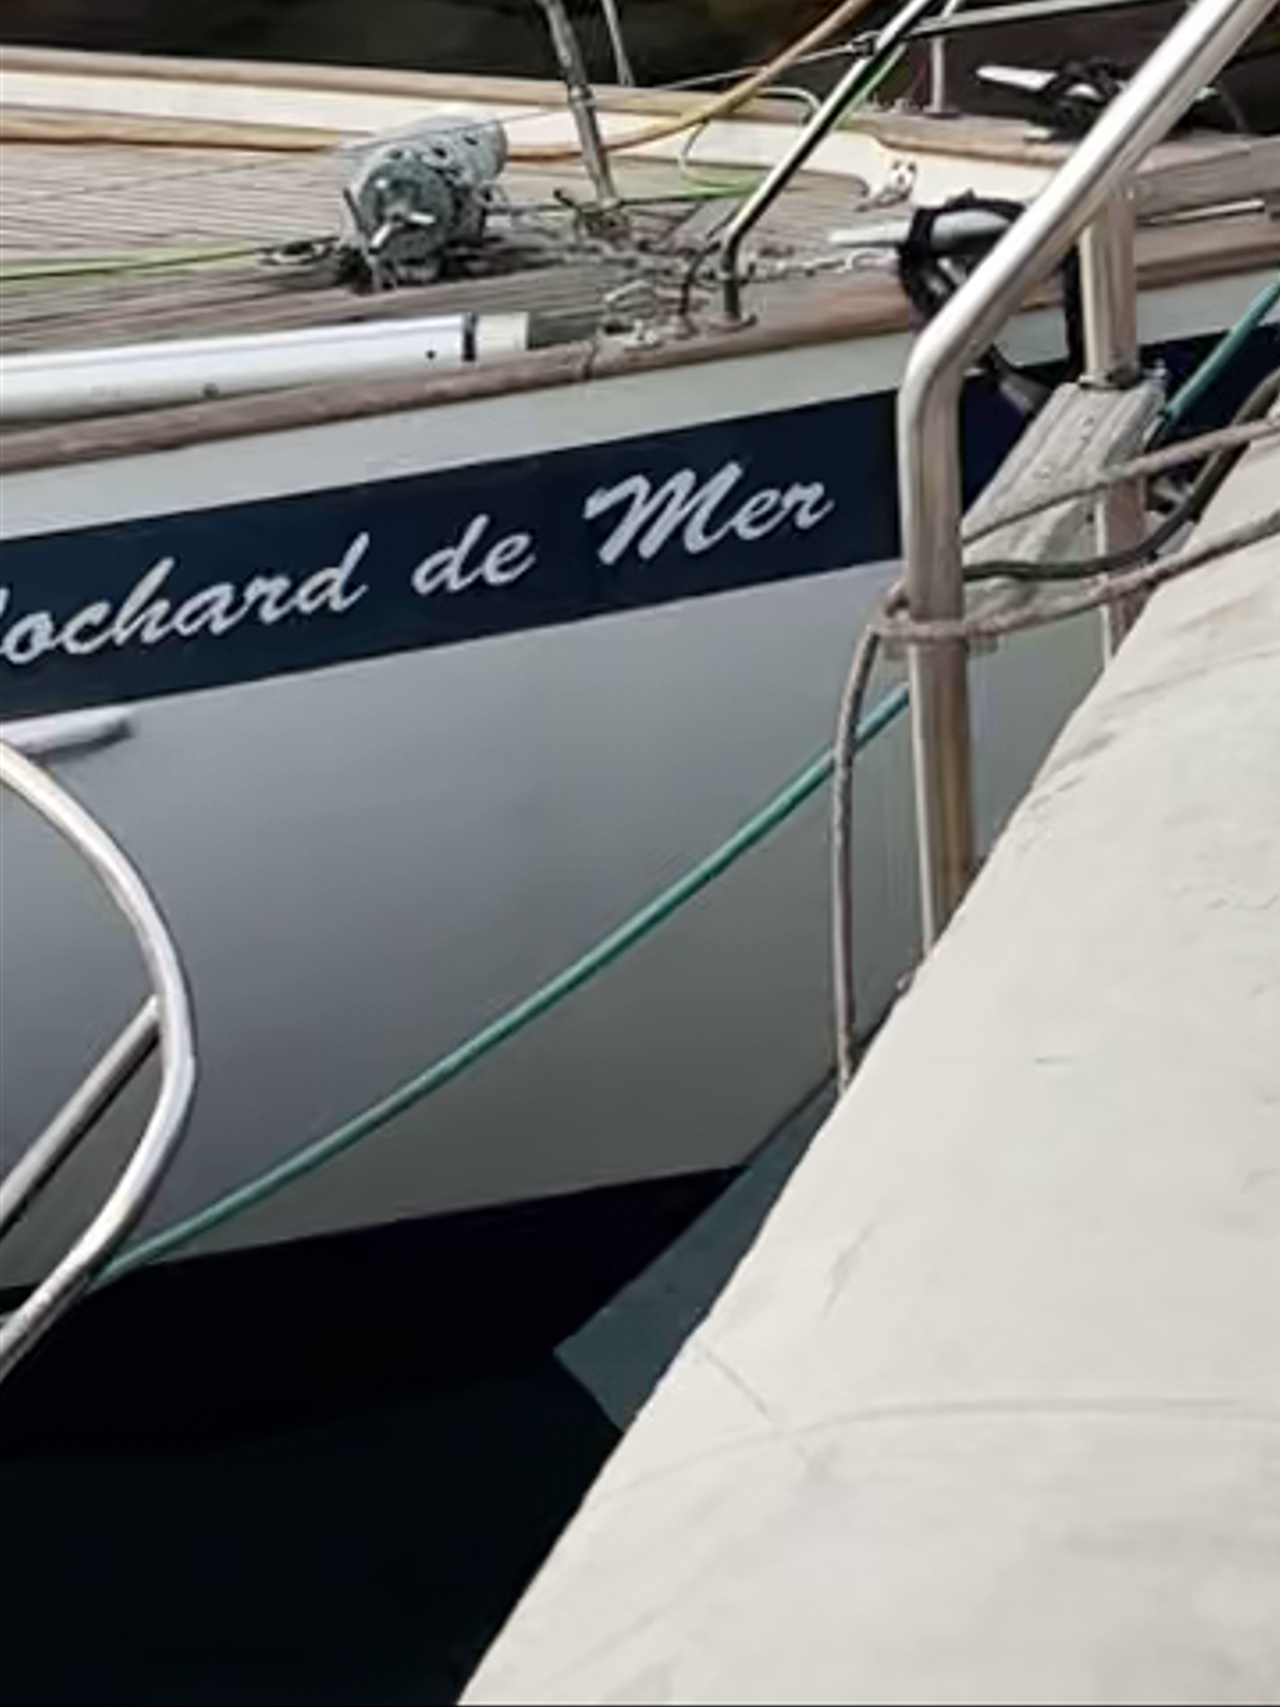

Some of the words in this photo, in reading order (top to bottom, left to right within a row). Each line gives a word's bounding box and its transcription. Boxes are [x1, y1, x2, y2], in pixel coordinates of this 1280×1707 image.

[0, 531, 370, 665] ochard
[411, 513, 536, 594] de
[582, 460, 834, 566] Mer
